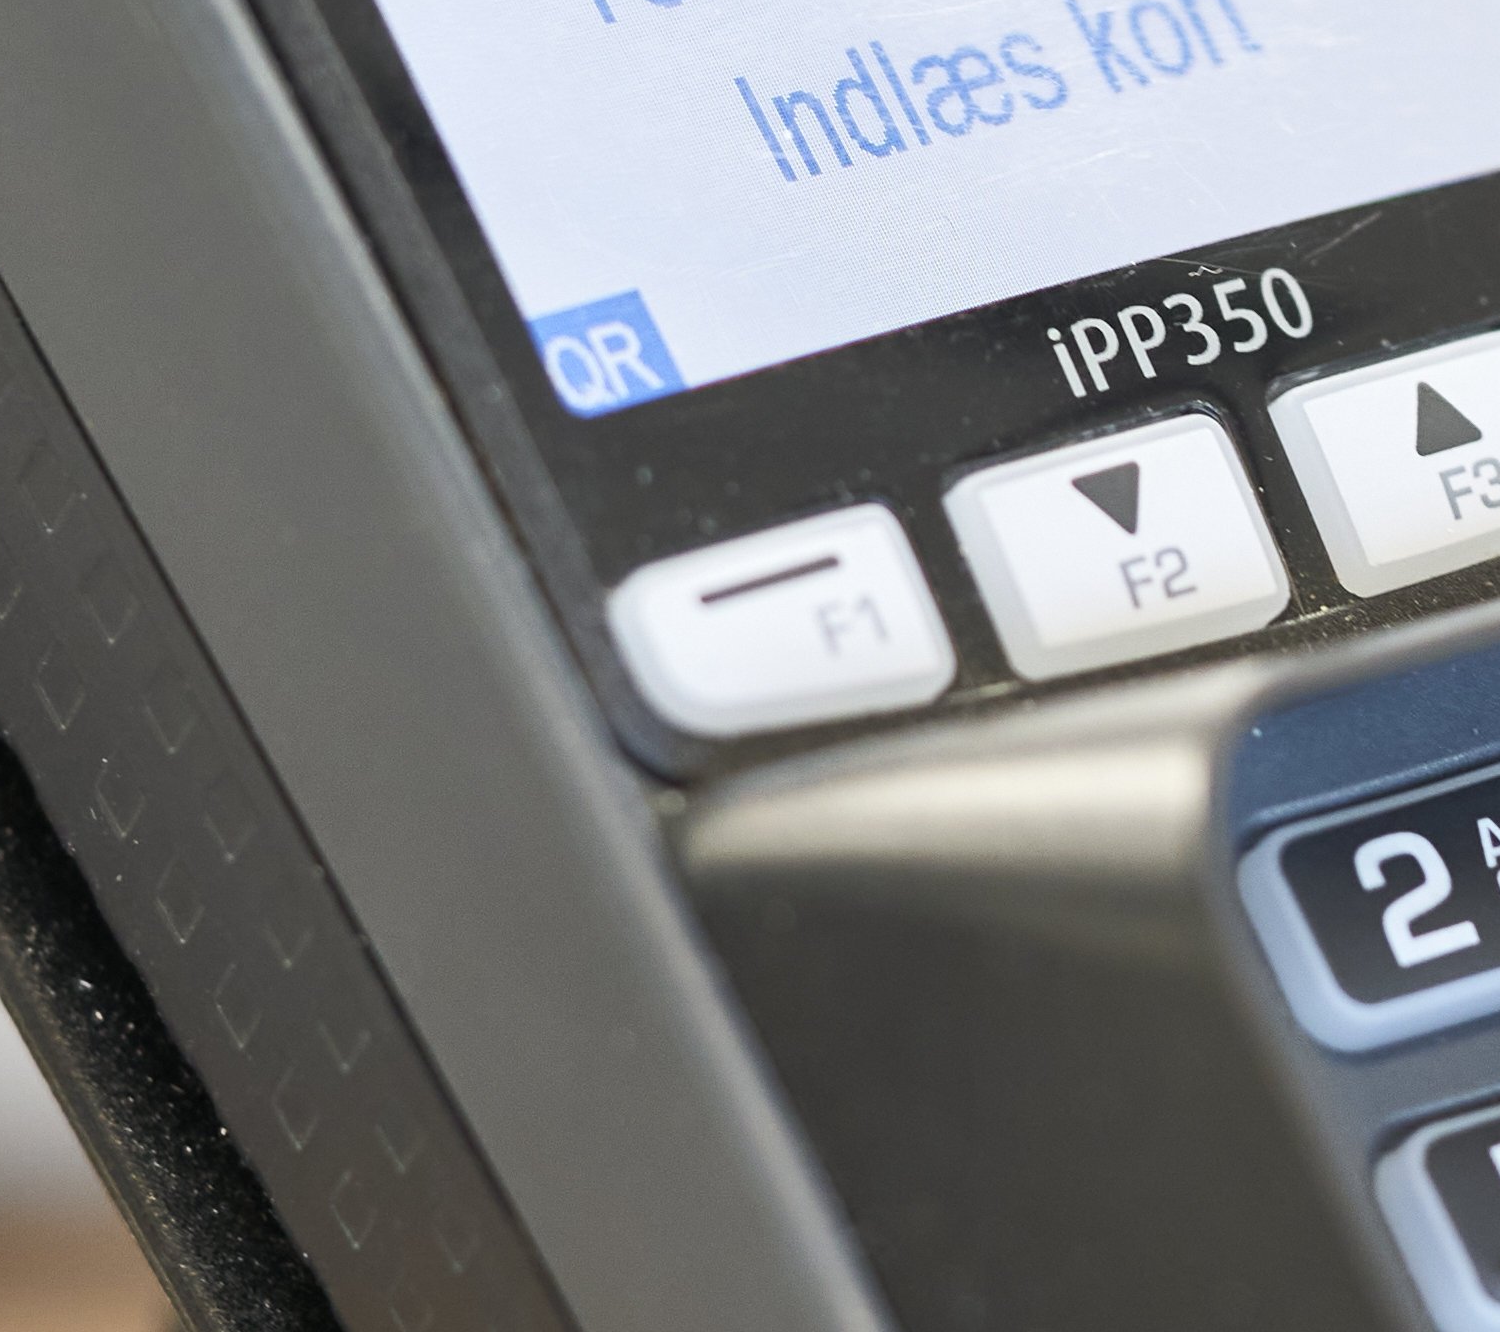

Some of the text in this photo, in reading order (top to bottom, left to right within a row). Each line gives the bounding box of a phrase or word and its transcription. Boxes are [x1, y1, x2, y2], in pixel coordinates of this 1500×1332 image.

[734, 29, 1071, 183] Indlæs
[543, 321, 666, 408] QR
[1046, 267, 1314, 400] iPP350
[814, 596, 890, 657] F1
[1119, 547, 1198, 610] F2
[1353, 831, 1481, 969] 2
